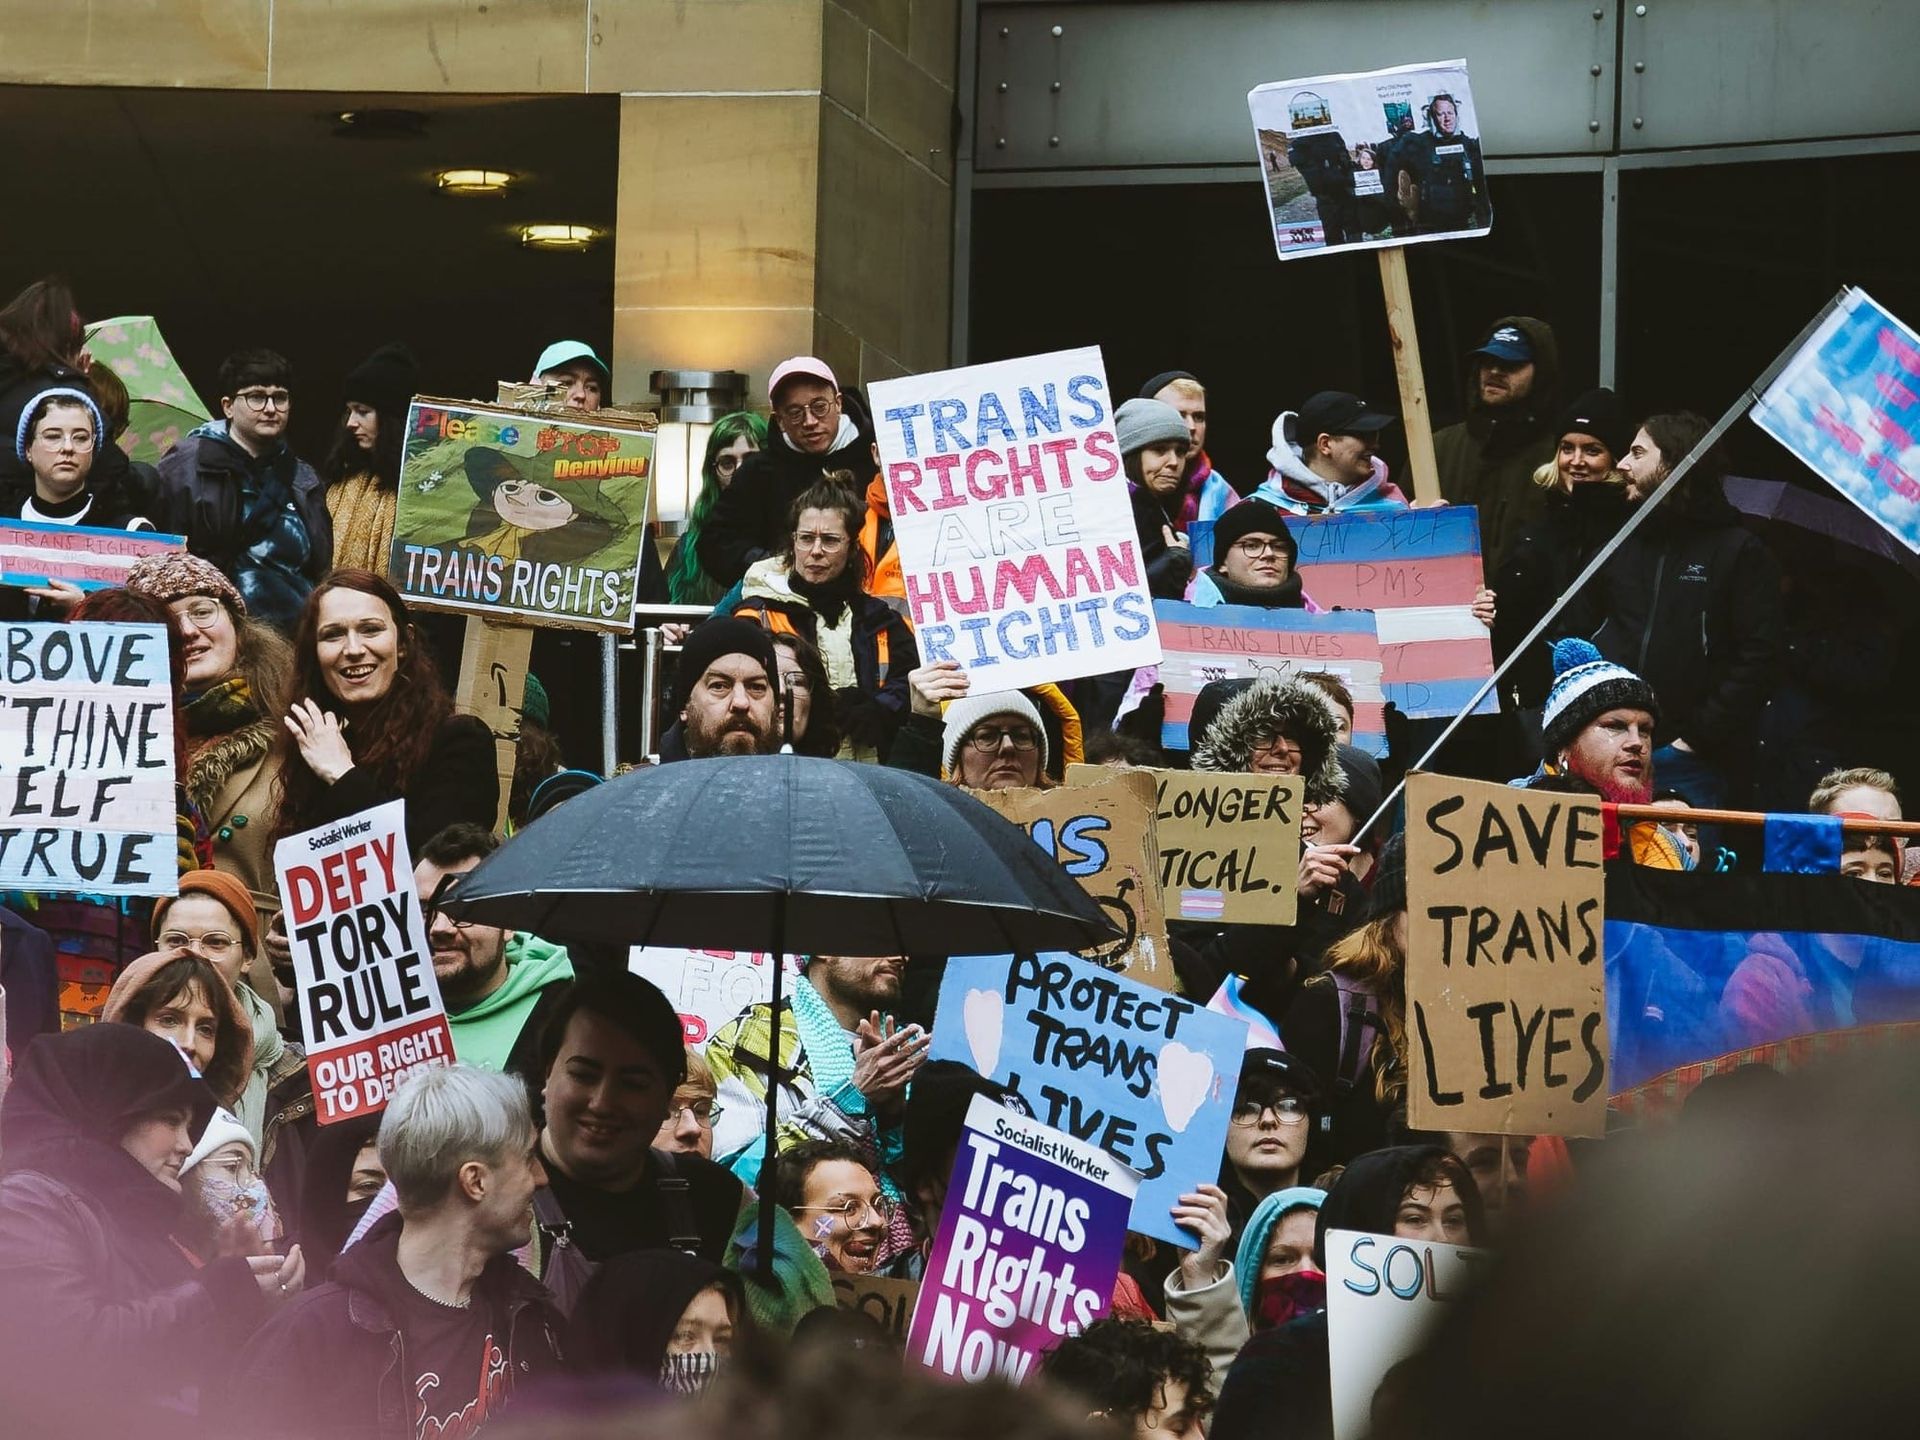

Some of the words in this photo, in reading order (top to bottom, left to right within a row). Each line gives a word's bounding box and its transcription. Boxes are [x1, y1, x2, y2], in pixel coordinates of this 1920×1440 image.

[535, 425, 621, 459] STOP
[885, 375, 1105, 458] TRANS
[553, 455, 649, 480] Denying
[888, 431, 1120, 517] RIGHTS
[8, 530, 73, 550] TRANS
[86, 537, 148, 556] RIGHTS
[932, 492, 1081, 567] ARE
[1300, 518, 1353, 565] CAN
[1372, 512, 1452, 551] SELF
[6, 556, 63, 577] HUMAN
[404, 543, 504, 603] TRANS
[509, 558, 621, 618] RIGHTS
[906, 540, 1140, 625] HUMAN
[0, 627, 153, 687] BOVE
[920, 592, 1151, 670] RIGHTS
[1177, 626, 1260, 653] TRANS
[1277, 632, 1344, 657] LIVES
[0, 764, 133, 823] ELF
[1157, 779, 1293, 828] LONGER
[308, 829, 343, 851] Socialist
[342, 819, 372, 838] Worker
[1425, 795, 1601, 875] SAVE
[285, 832, 397, 926] DEFY
[295, 890, 413, 982] TORY
[1427, 898, 1599, 968] TRANS
[307, 952, 431, 1044] RULE
[1005, 951, 1194, 1039] PROTECT
[316, 1051, 375, 1089] OUR
[377, 1025, 444, 1073] RIGHT
[1027, 1010, 1158, 1098] TRANS
[1413, 1000, 1605, 1107] LIVES
[319, 1085, 359, 1117] TO
[994, 1118, 1060, 1161] Socialist
[1059, 1149, 1111, 1182] Worker
[967, 1132, 1090, 1253] Trans
[942, 1214, 1101, 1338] Rights
[1344, 1236, 1484, 1302] SOL
